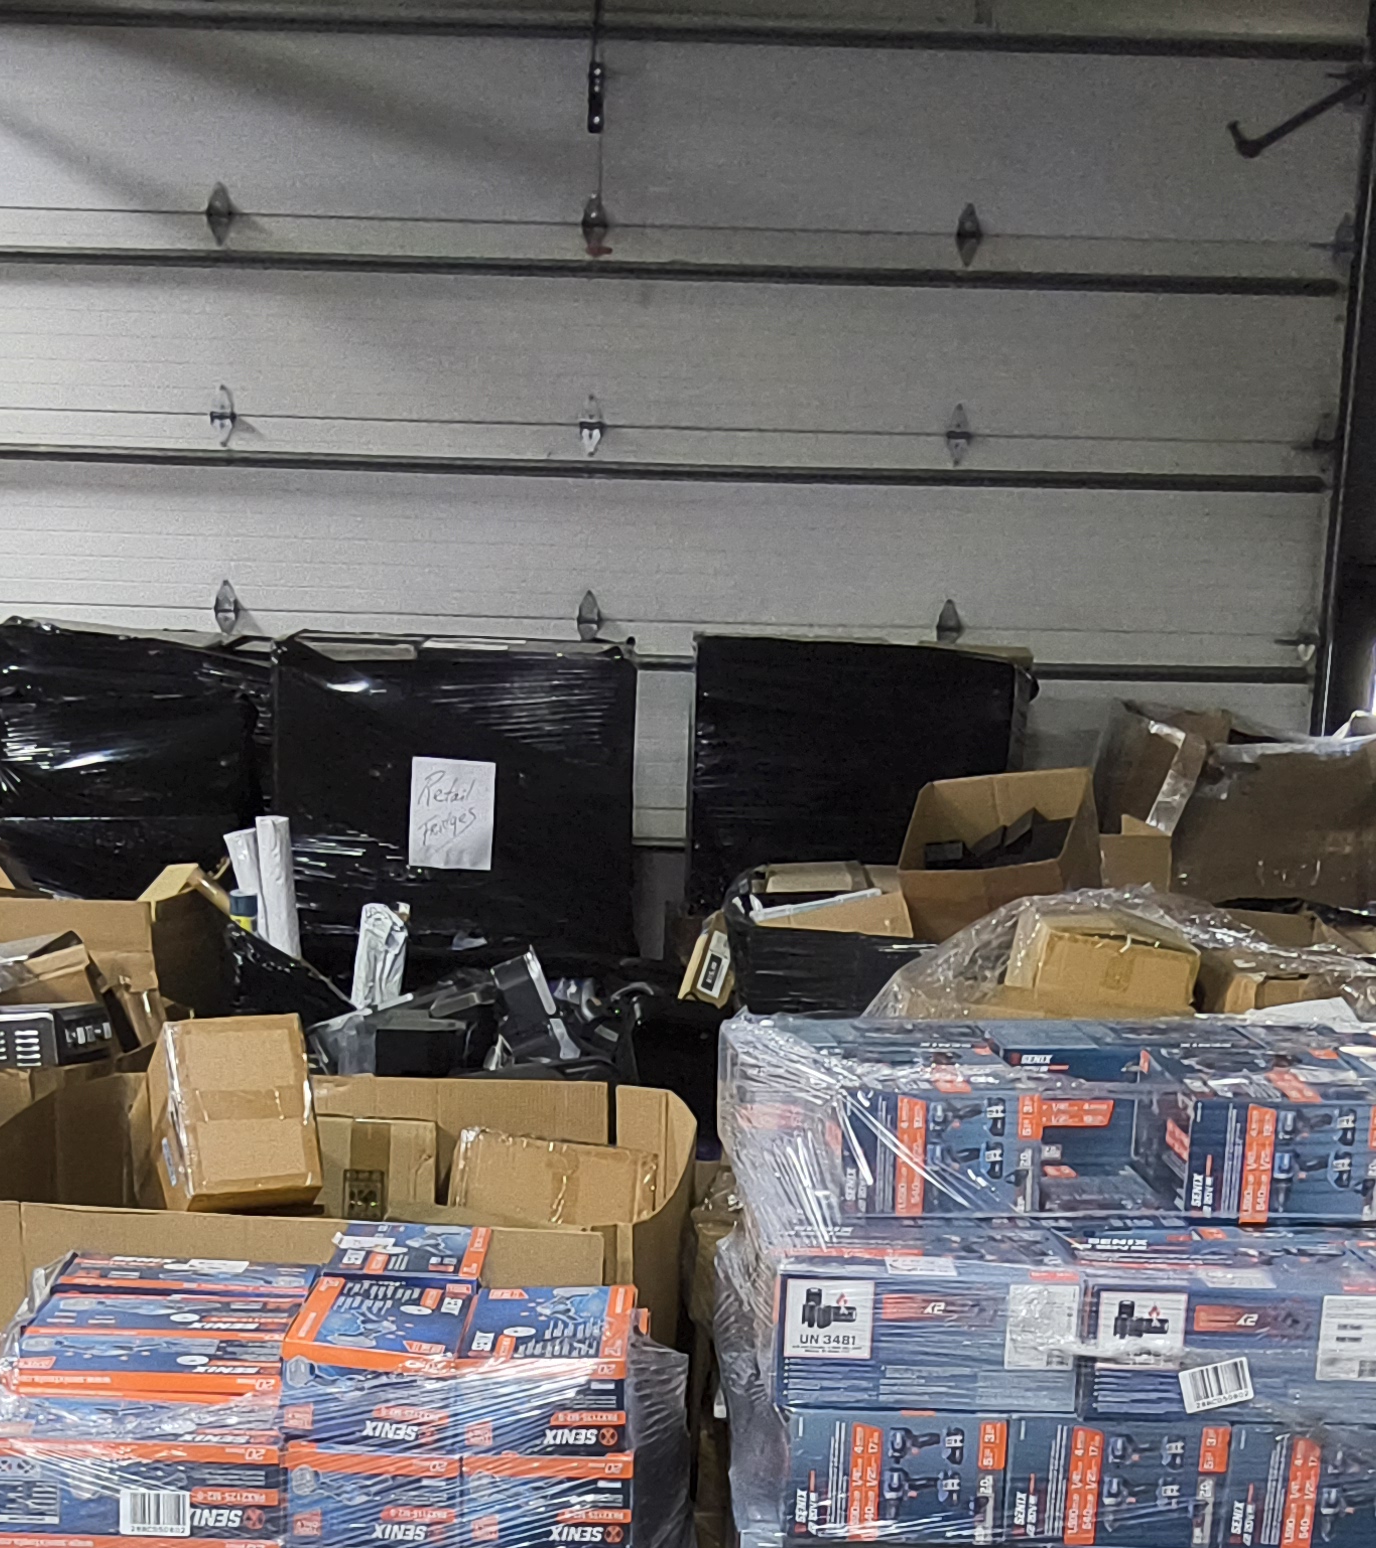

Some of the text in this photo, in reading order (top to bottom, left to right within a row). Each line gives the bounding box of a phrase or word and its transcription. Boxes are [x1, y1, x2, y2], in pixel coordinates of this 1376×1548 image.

[417, 769, 475, 808] Retail
[799, 1334, 856, 1346] UN 3481
[362, 1420, 419, 1441] SENIX
[544, 1428, 598, 1445] SENIX
[1013, 1491, 1027, 1526] SENIX
[1230, 1500, 1245, 1535] SENIX
[372, 1522, 427, 1541] SENIX
[549, 1525, 604, 1543] SENIX
